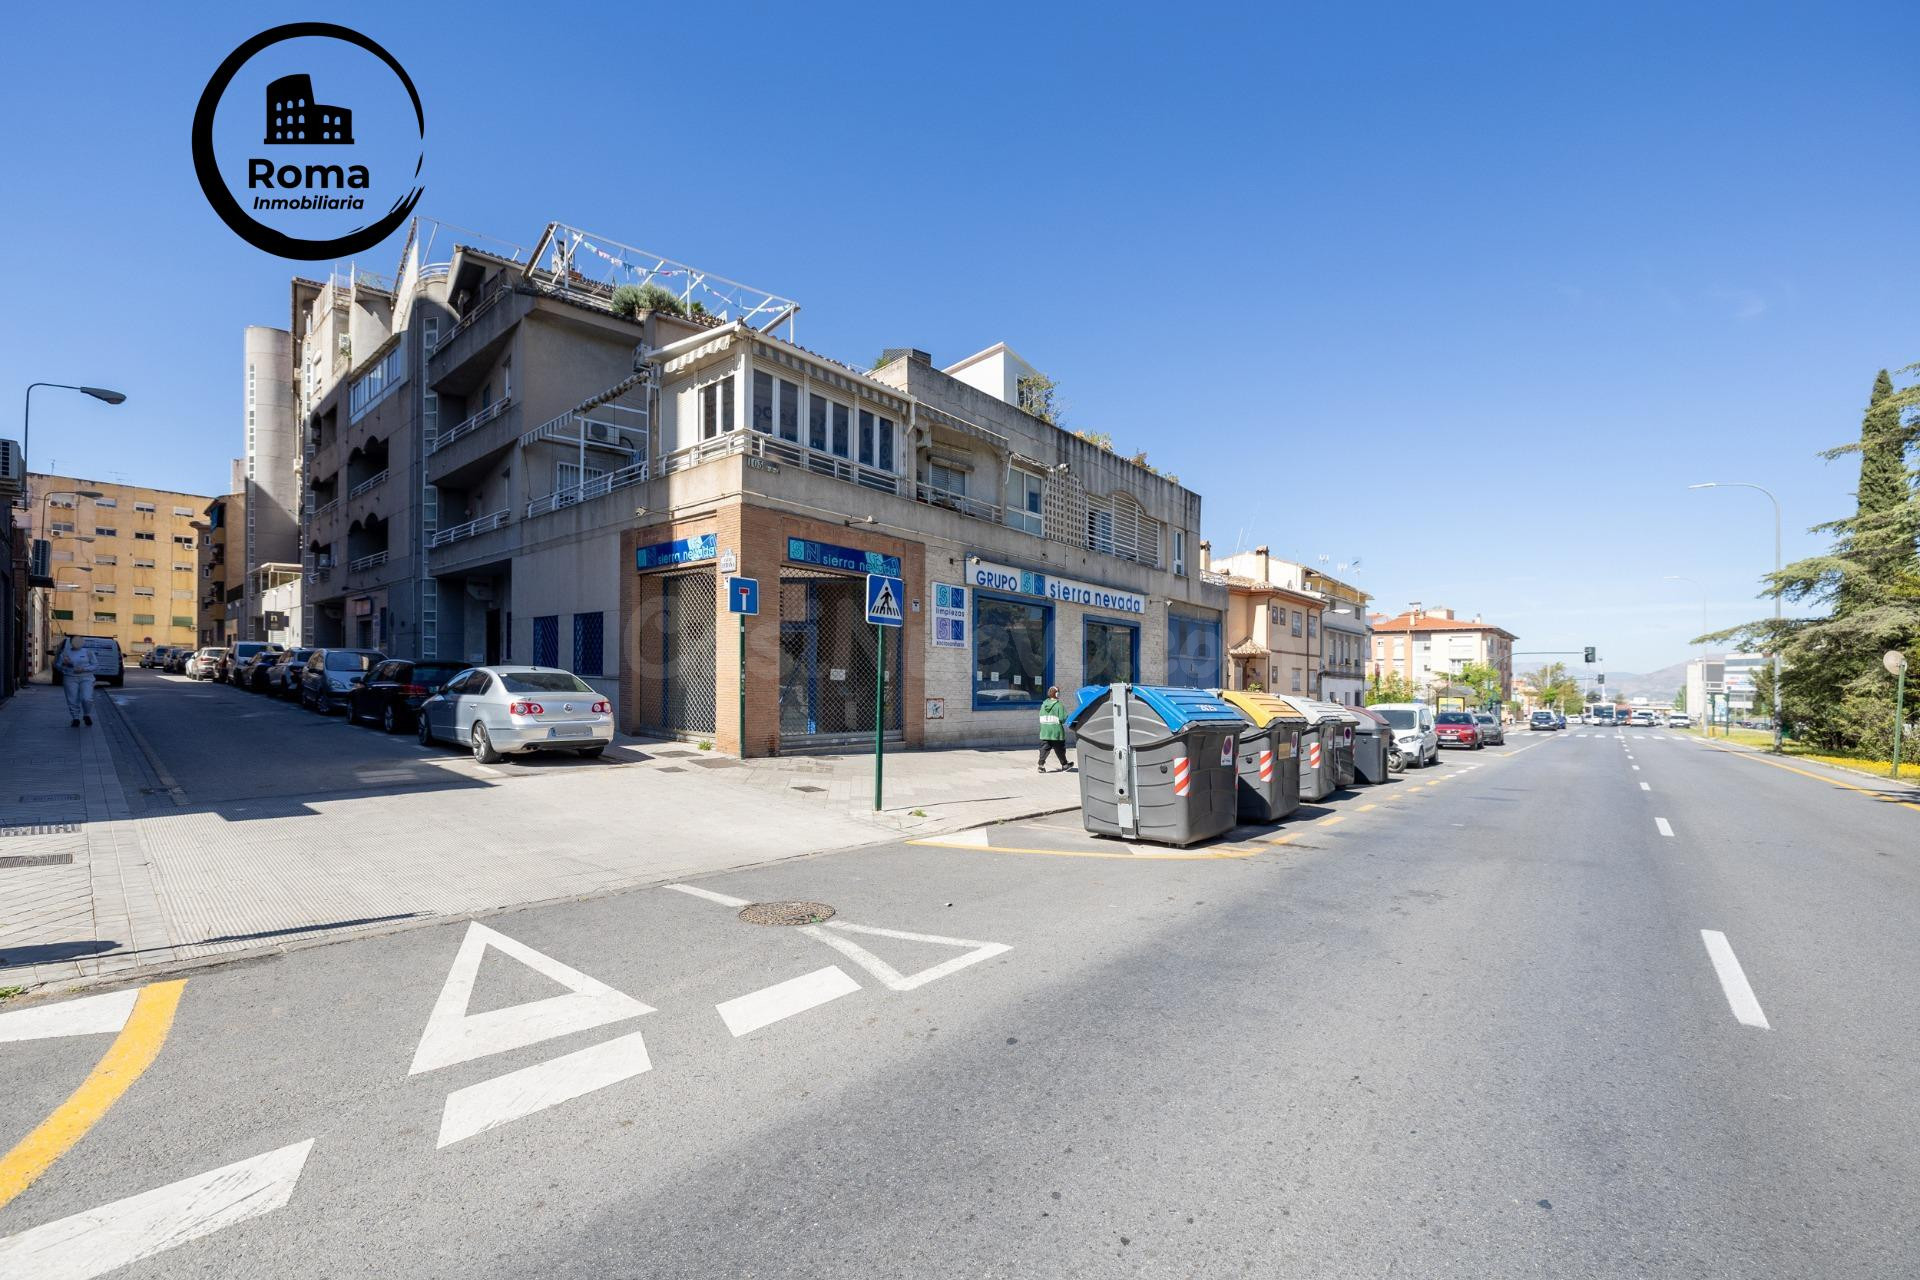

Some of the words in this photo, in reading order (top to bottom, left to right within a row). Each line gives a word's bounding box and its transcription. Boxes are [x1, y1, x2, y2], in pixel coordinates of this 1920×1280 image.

[657, 551, 680, 565] sierra
[823, 554, 855, 569] sierra
[976, 570, 1018, 591] GRUPO
[1050, 581, 1091, 605] sierra
[1095, 593, 1140, 612] nevada
[936, 608, 965, 617] limpiezas
